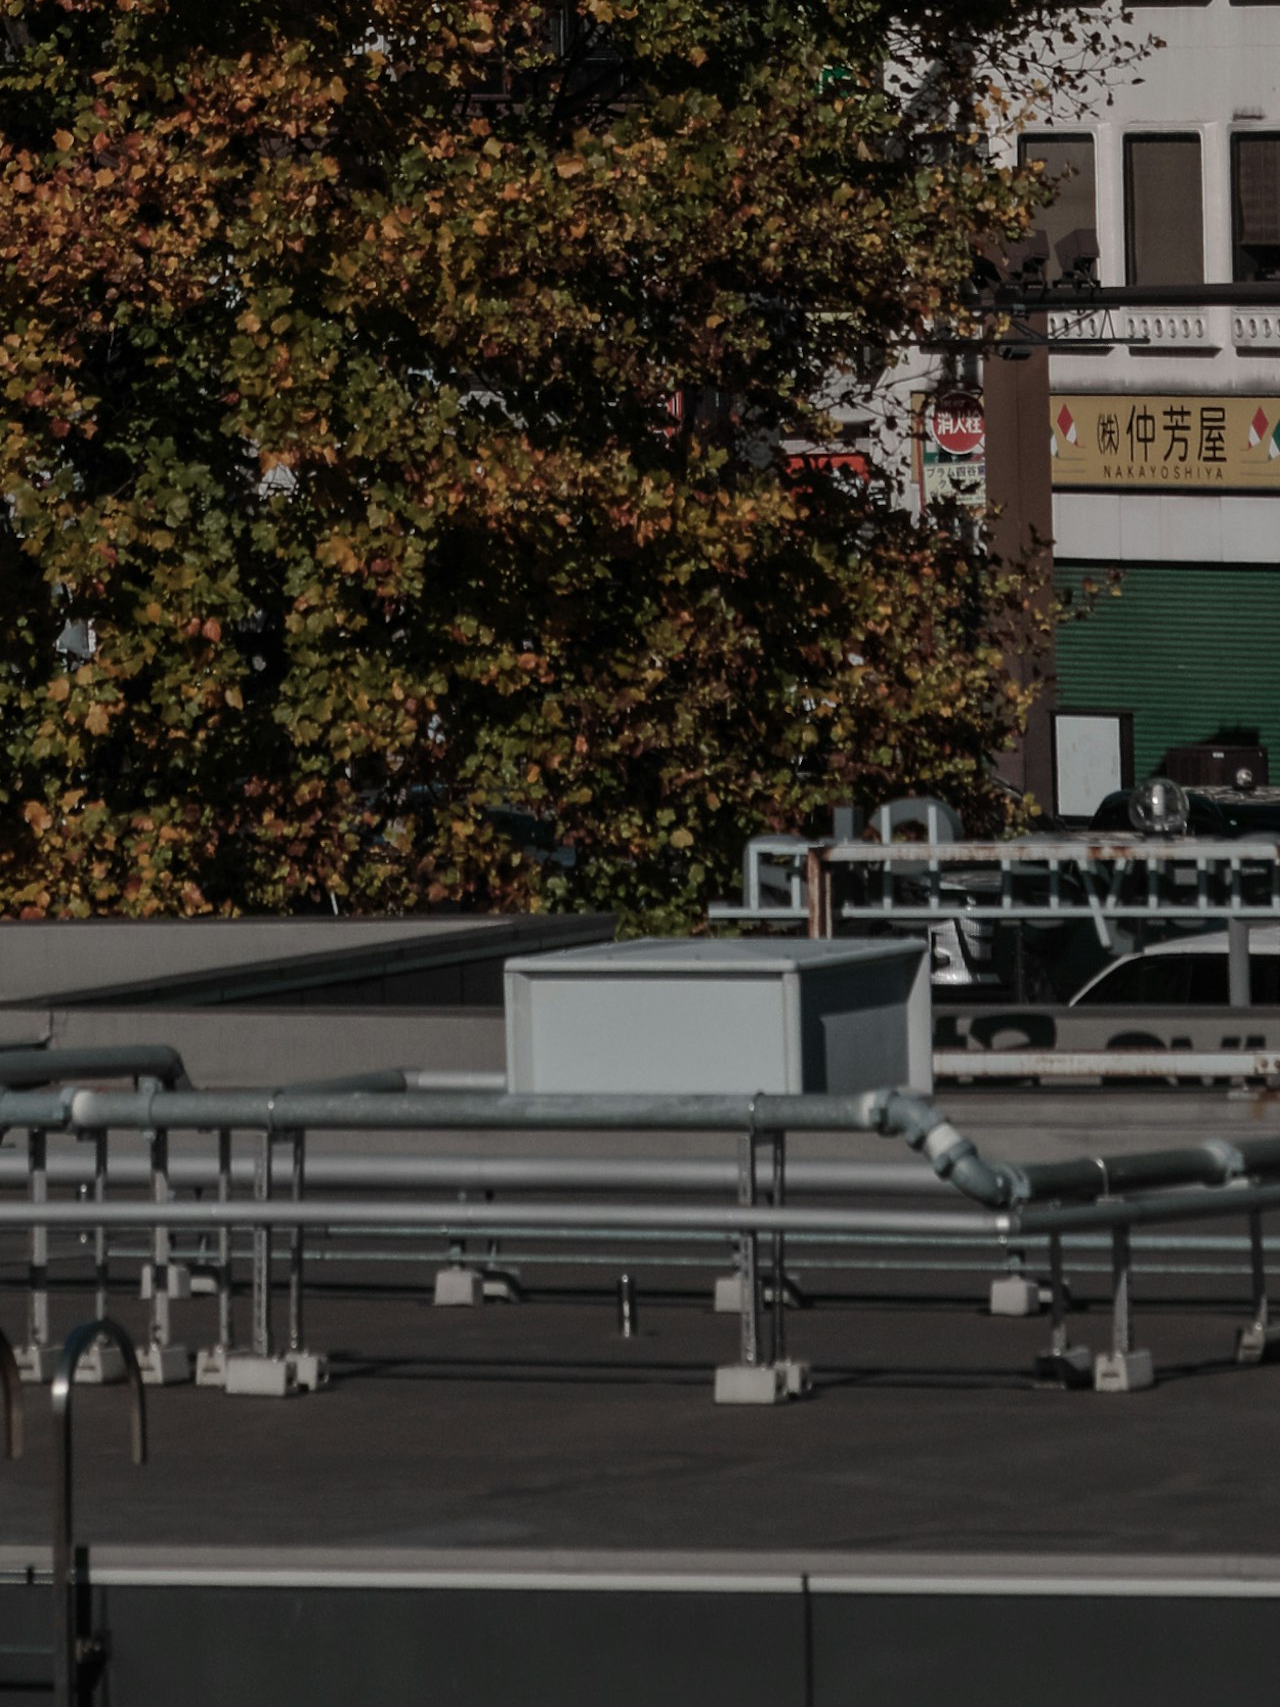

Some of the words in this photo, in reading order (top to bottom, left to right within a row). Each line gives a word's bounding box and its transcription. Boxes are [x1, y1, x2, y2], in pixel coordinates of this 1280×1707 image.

[937, 411, 984, 436] 消火栓
[1103, 464, 1224, 479] NAKAYOSHIYA
